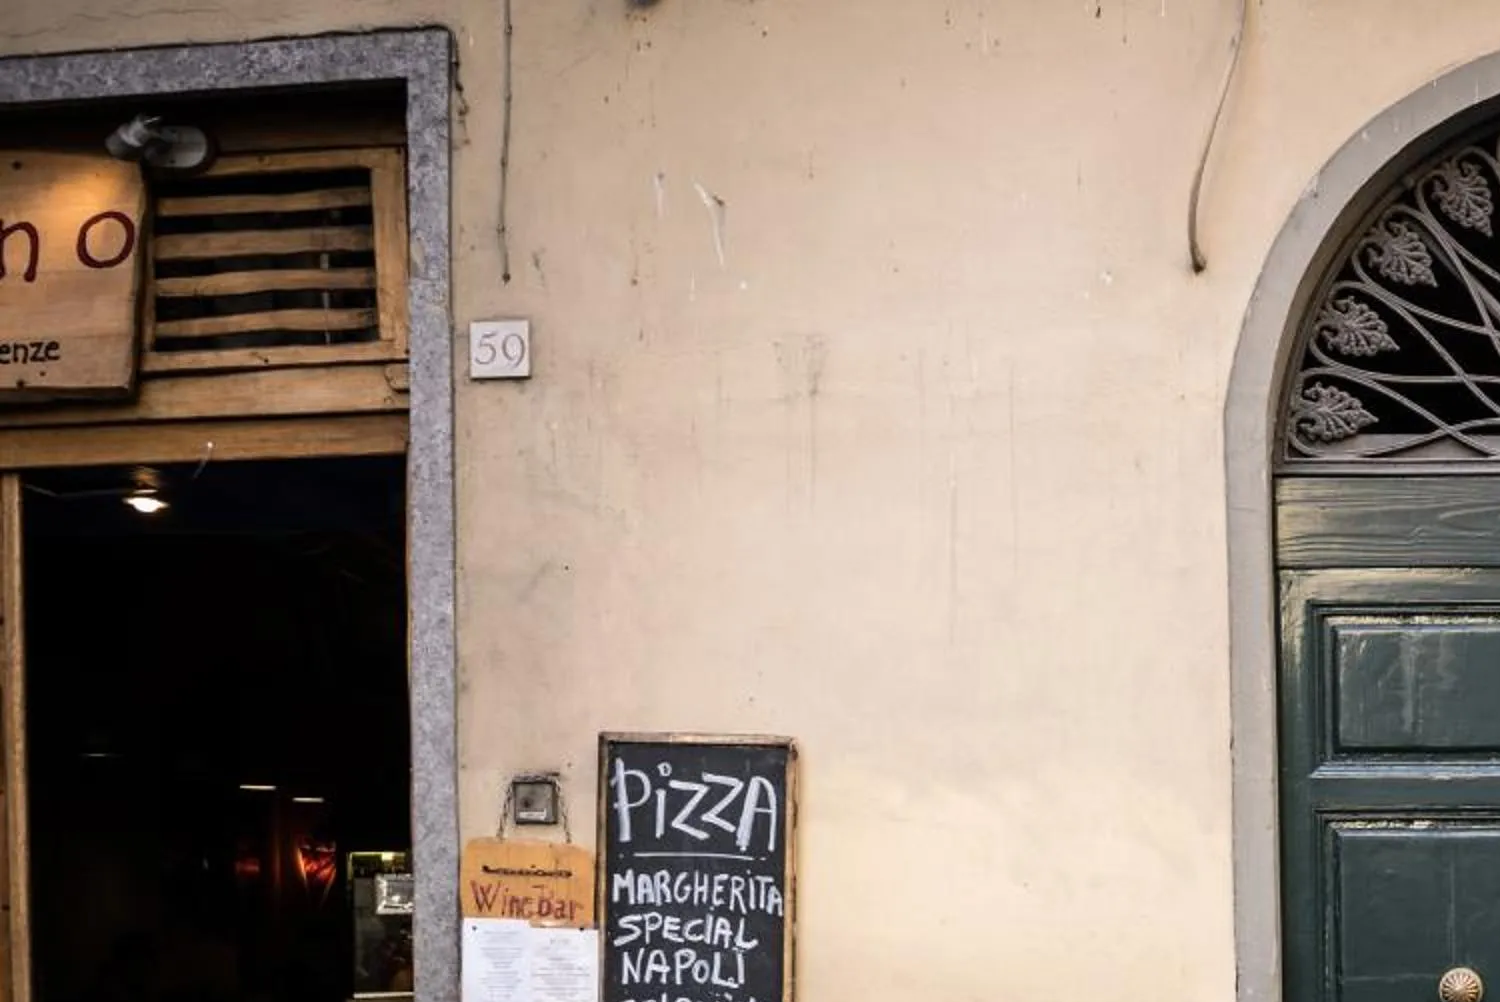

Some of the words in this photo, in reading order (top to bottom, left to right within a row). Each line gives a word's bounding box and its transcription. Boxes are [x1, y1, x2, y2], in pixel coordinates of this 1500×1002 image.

[0, 340, 61, 364] enze
[475, 330, 525, 369] 59
[613, 906, 759, 949] SPECIAL
